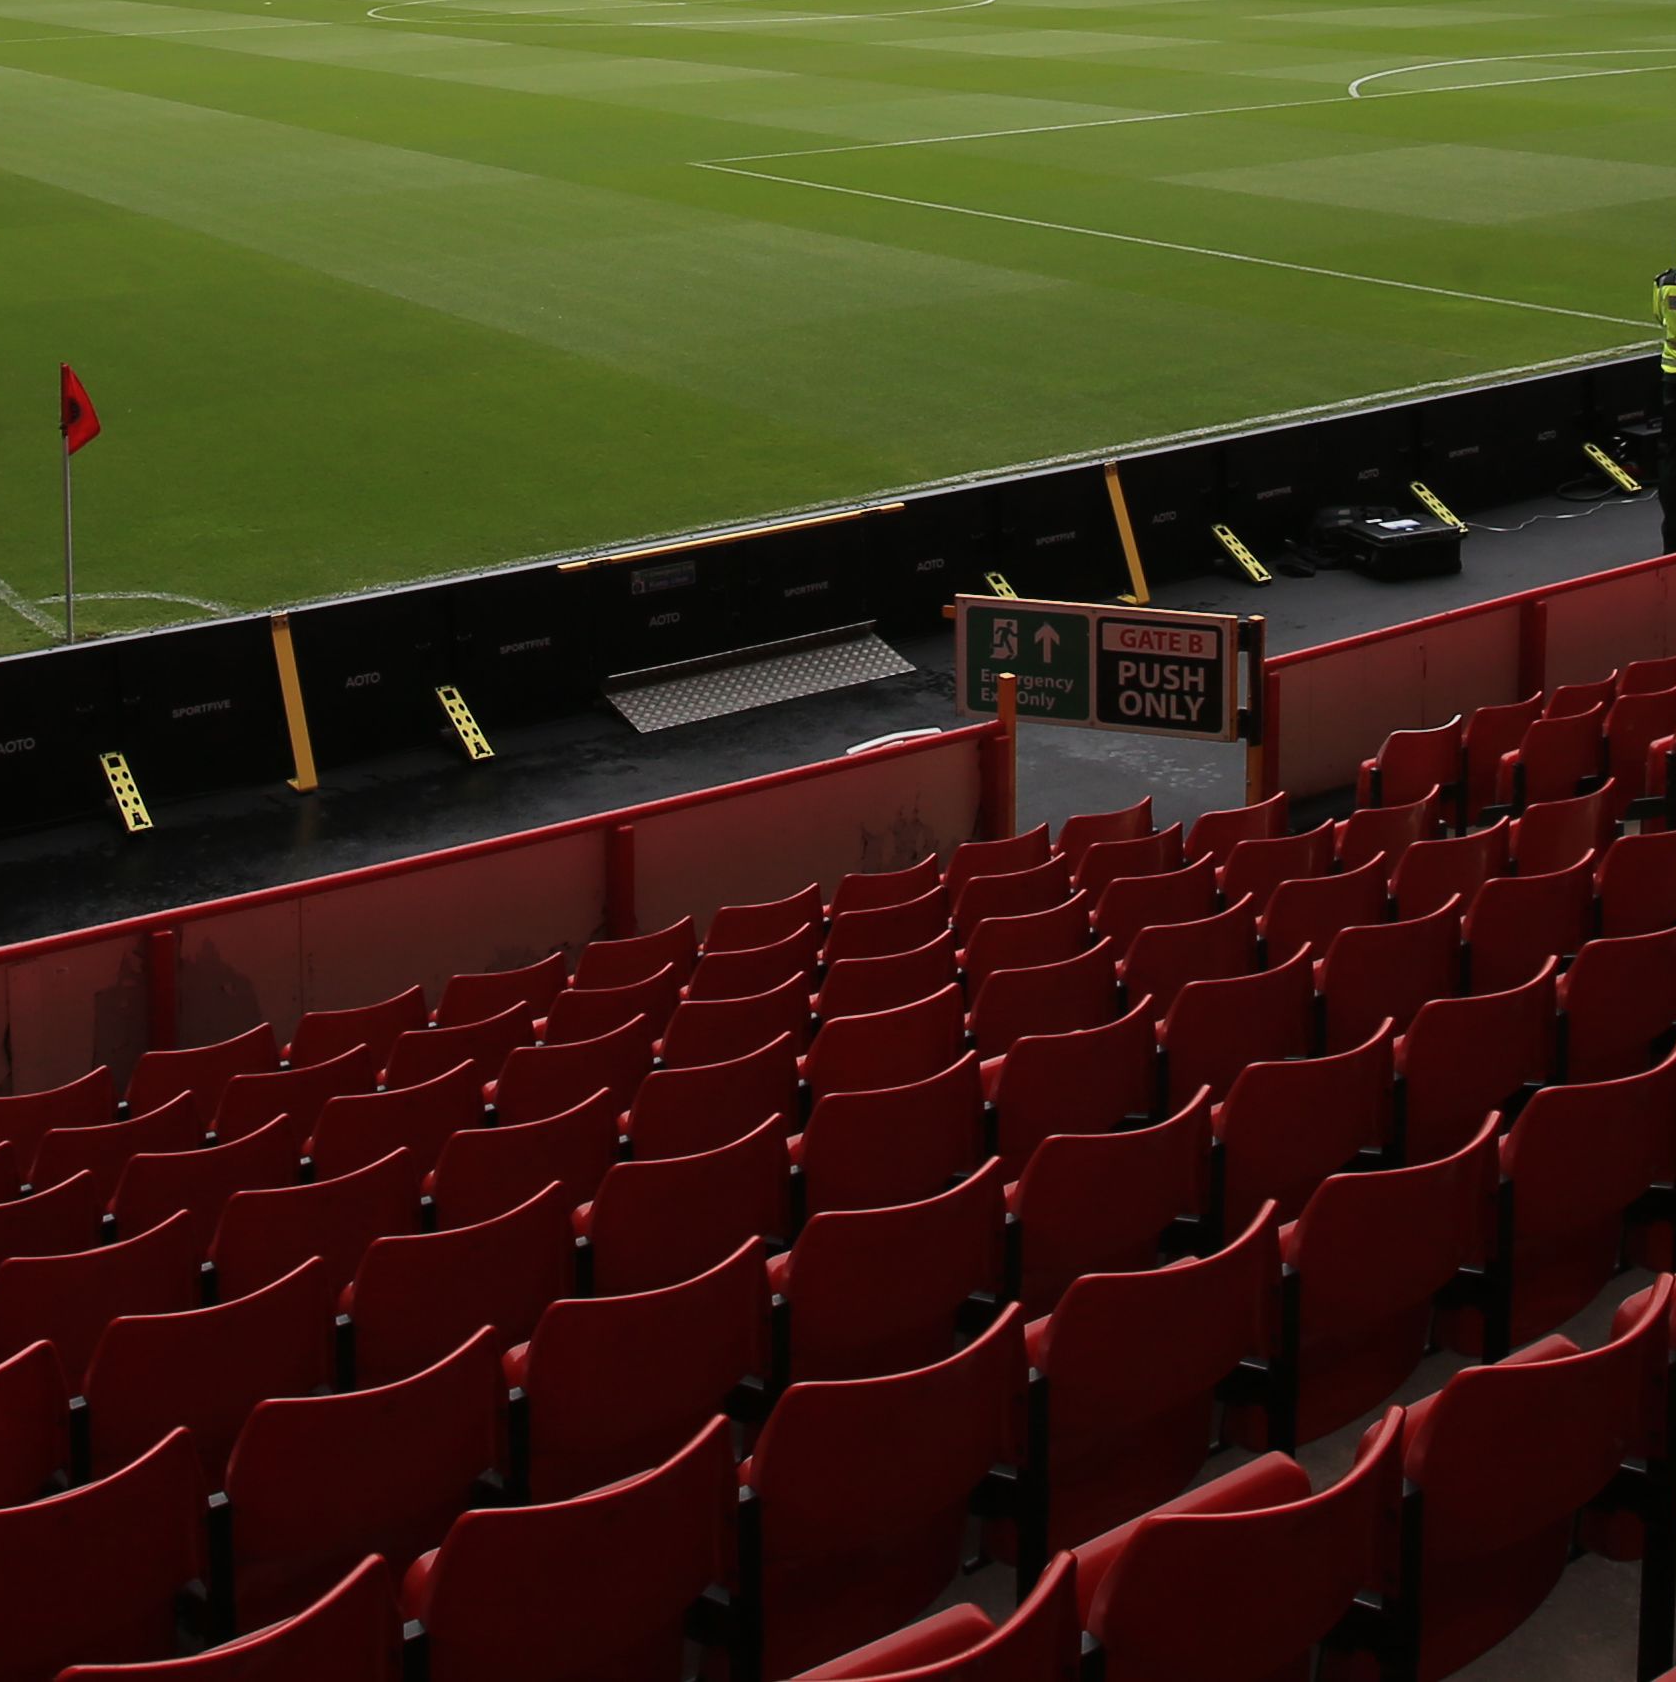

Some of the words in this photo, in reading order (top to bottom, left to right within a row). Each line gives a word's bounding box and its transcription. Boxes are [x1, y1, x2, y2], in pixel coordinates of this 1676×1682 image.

[1035, 531, 1076, 546] SPORTFIVE
[915, 558, 945, 572] AOTO
[784, 581, 828, 597] SPORTFIVE
[648, 612, 681, 628] AOTO
[499, 637, 552, 655] SPORTFIVE
[1120, 628, 1182, 653] GATE
[1188, 634, 1204, 655] B
[345, 672, 381, 689] AOTO
[1118, 660, 1205, 693] PUSH
[172, 699, 232, 719] SPORTFIVE
[1018, 691, 1056, 711] Only
[1118, 689, 1205, 722] ONLY
